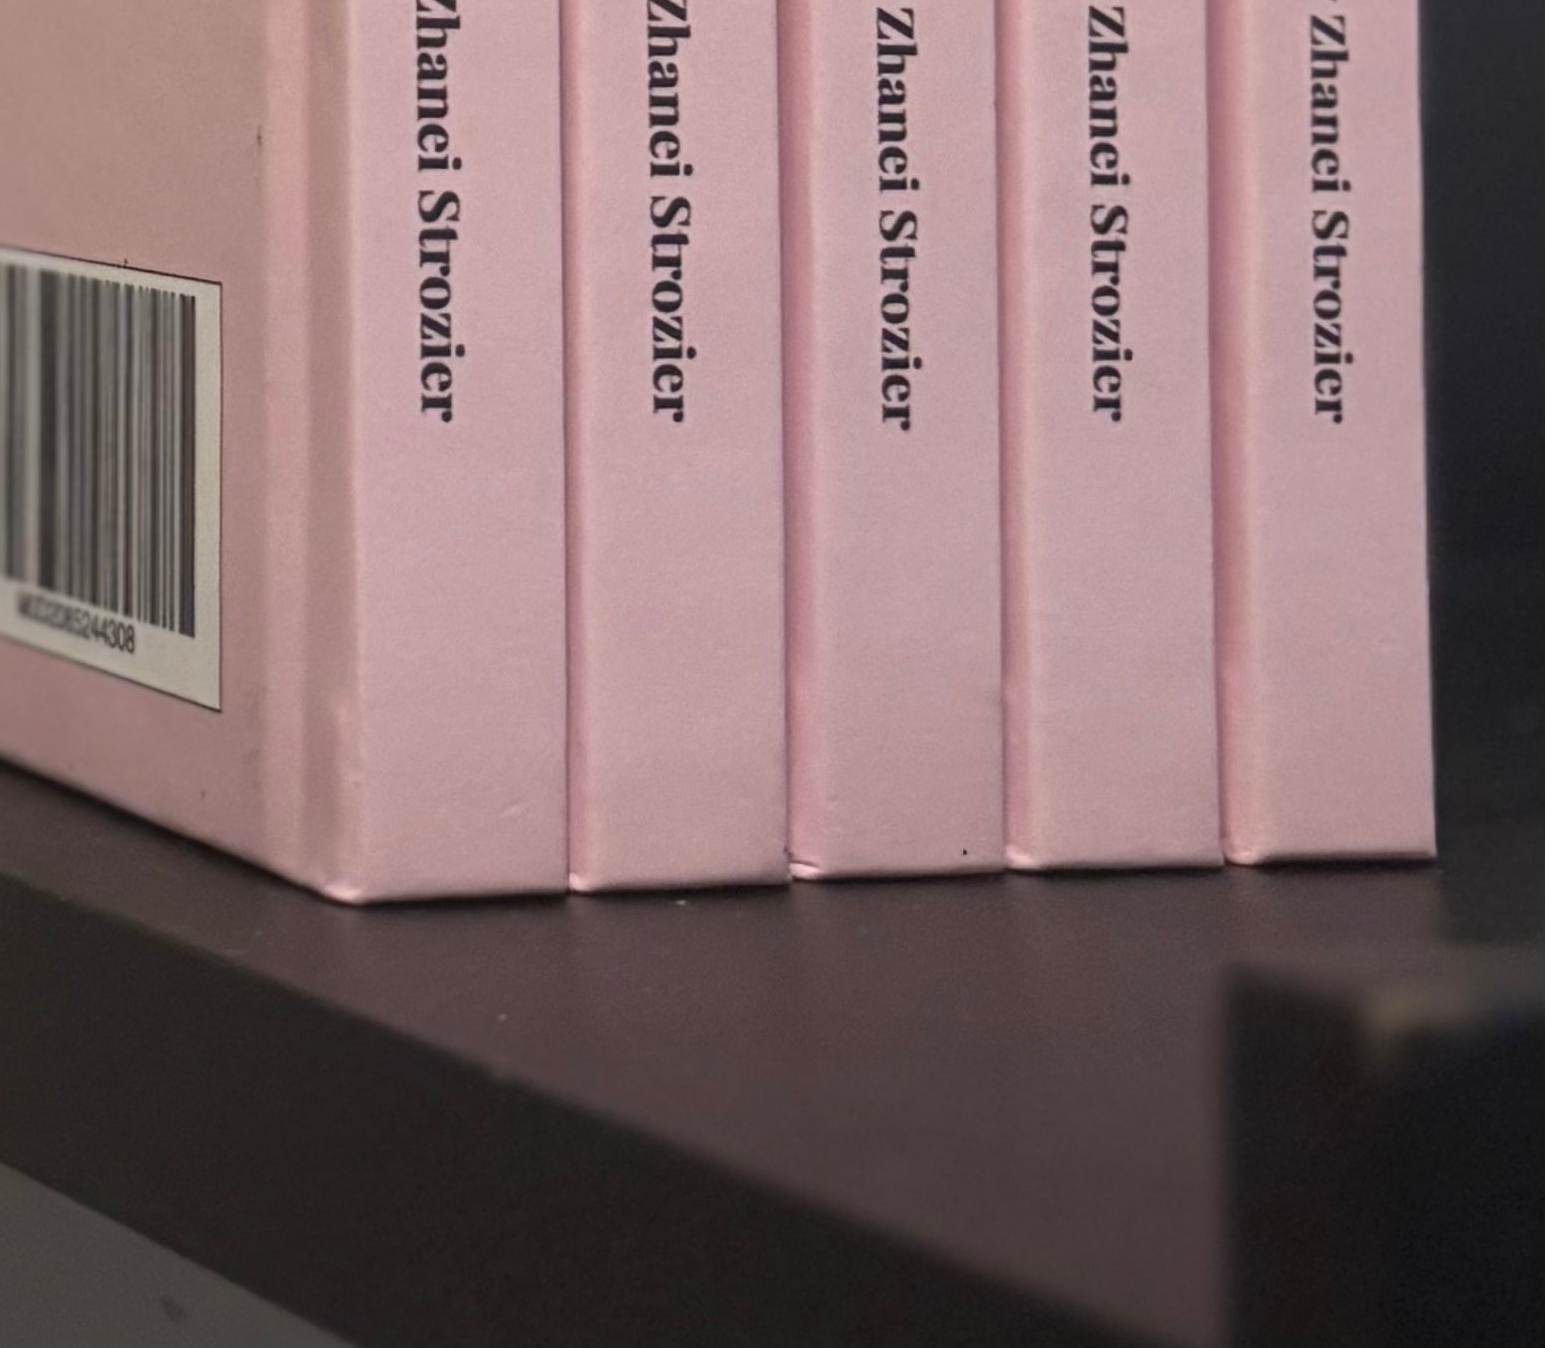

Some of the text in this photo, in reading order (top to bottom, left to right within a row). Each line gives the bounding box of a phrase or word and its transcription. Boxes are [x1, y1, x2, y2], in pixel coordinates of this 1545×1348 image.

[874, 6, 922, 194] Zhanei
[1086, 3, 1132, 188] Zhanei
[1308, 12, 1353, 194] Zhanei
[416, 188, 467, 425] Strozier
[648, 194, 699, 425] Strozier
[877, 208, 924, 433] Strozier
[1088, 202, 1135, 424] Strozier
[1310, 208, 1355, 426] Strozier
